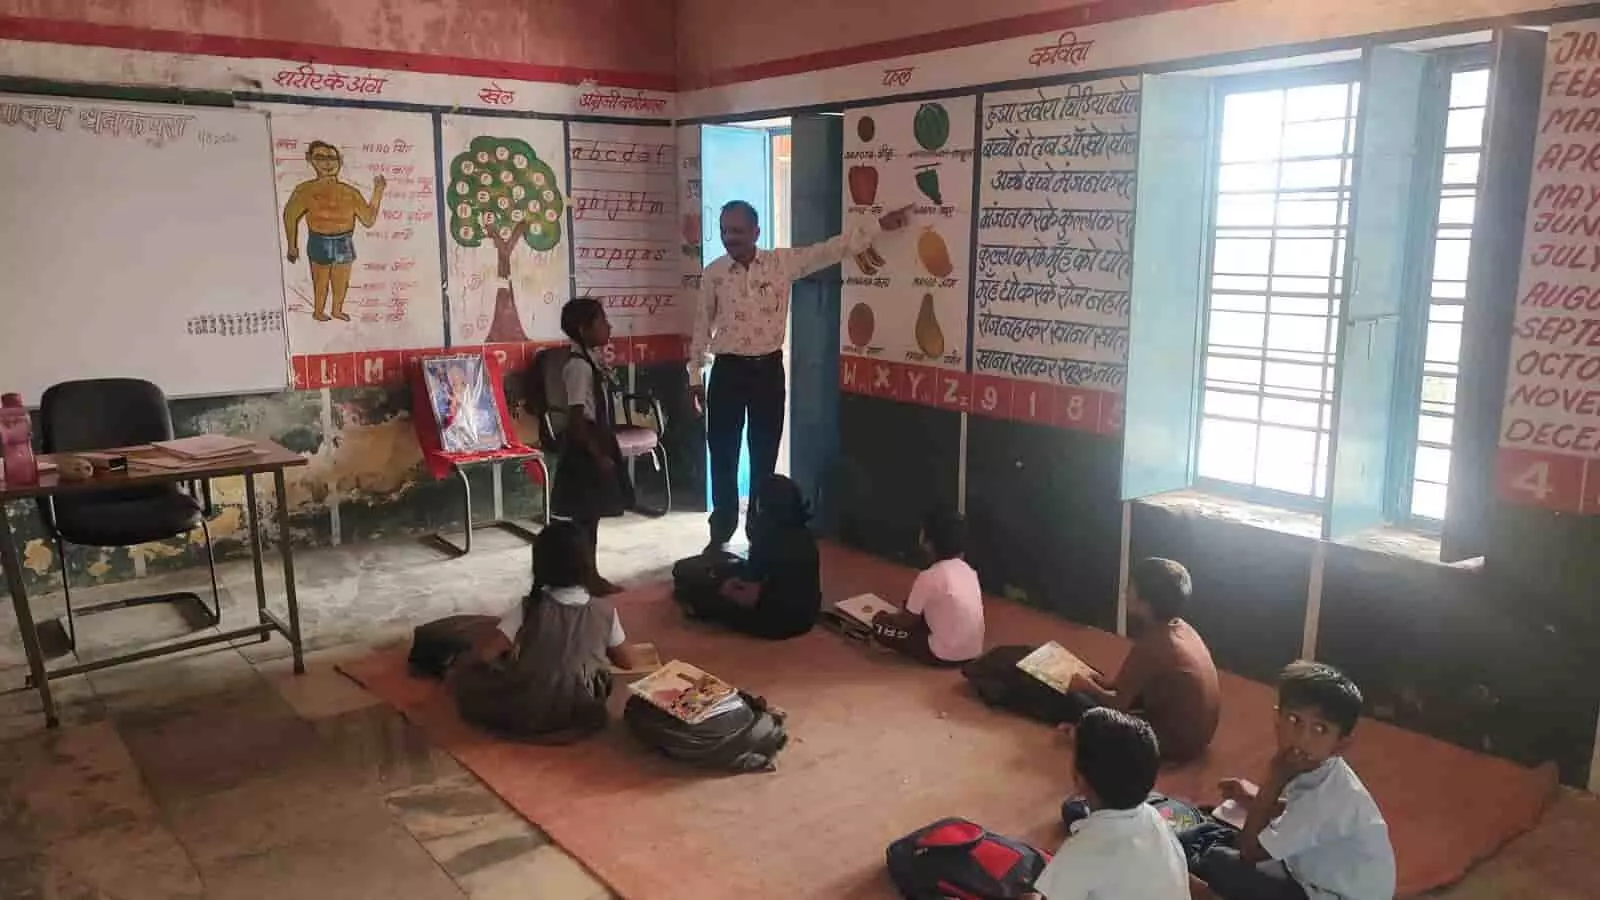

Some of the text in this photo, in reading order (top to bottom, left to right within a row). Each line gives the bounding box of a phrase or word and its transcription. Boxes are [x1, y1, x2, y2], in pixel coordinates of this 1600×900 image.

[1028, 32, 1096, 67] कविता
[1554, 31, 1600, 64] JA
[1542, 107, 1600, 133] MA
[1534, 212, 1600, 237] JUN
[843, 361, 857, 387] W
[873, 365, 892, 388] X
[907, 371, 926, 399] Y
[981, 385, 998, 411] 9
[1067, 395, 1085, 421] 8
[1511, 385, 1600, 416] NOVE
[1505, 418, 1600, 450] DECE
[1511, 462, 1553, 499] 4
